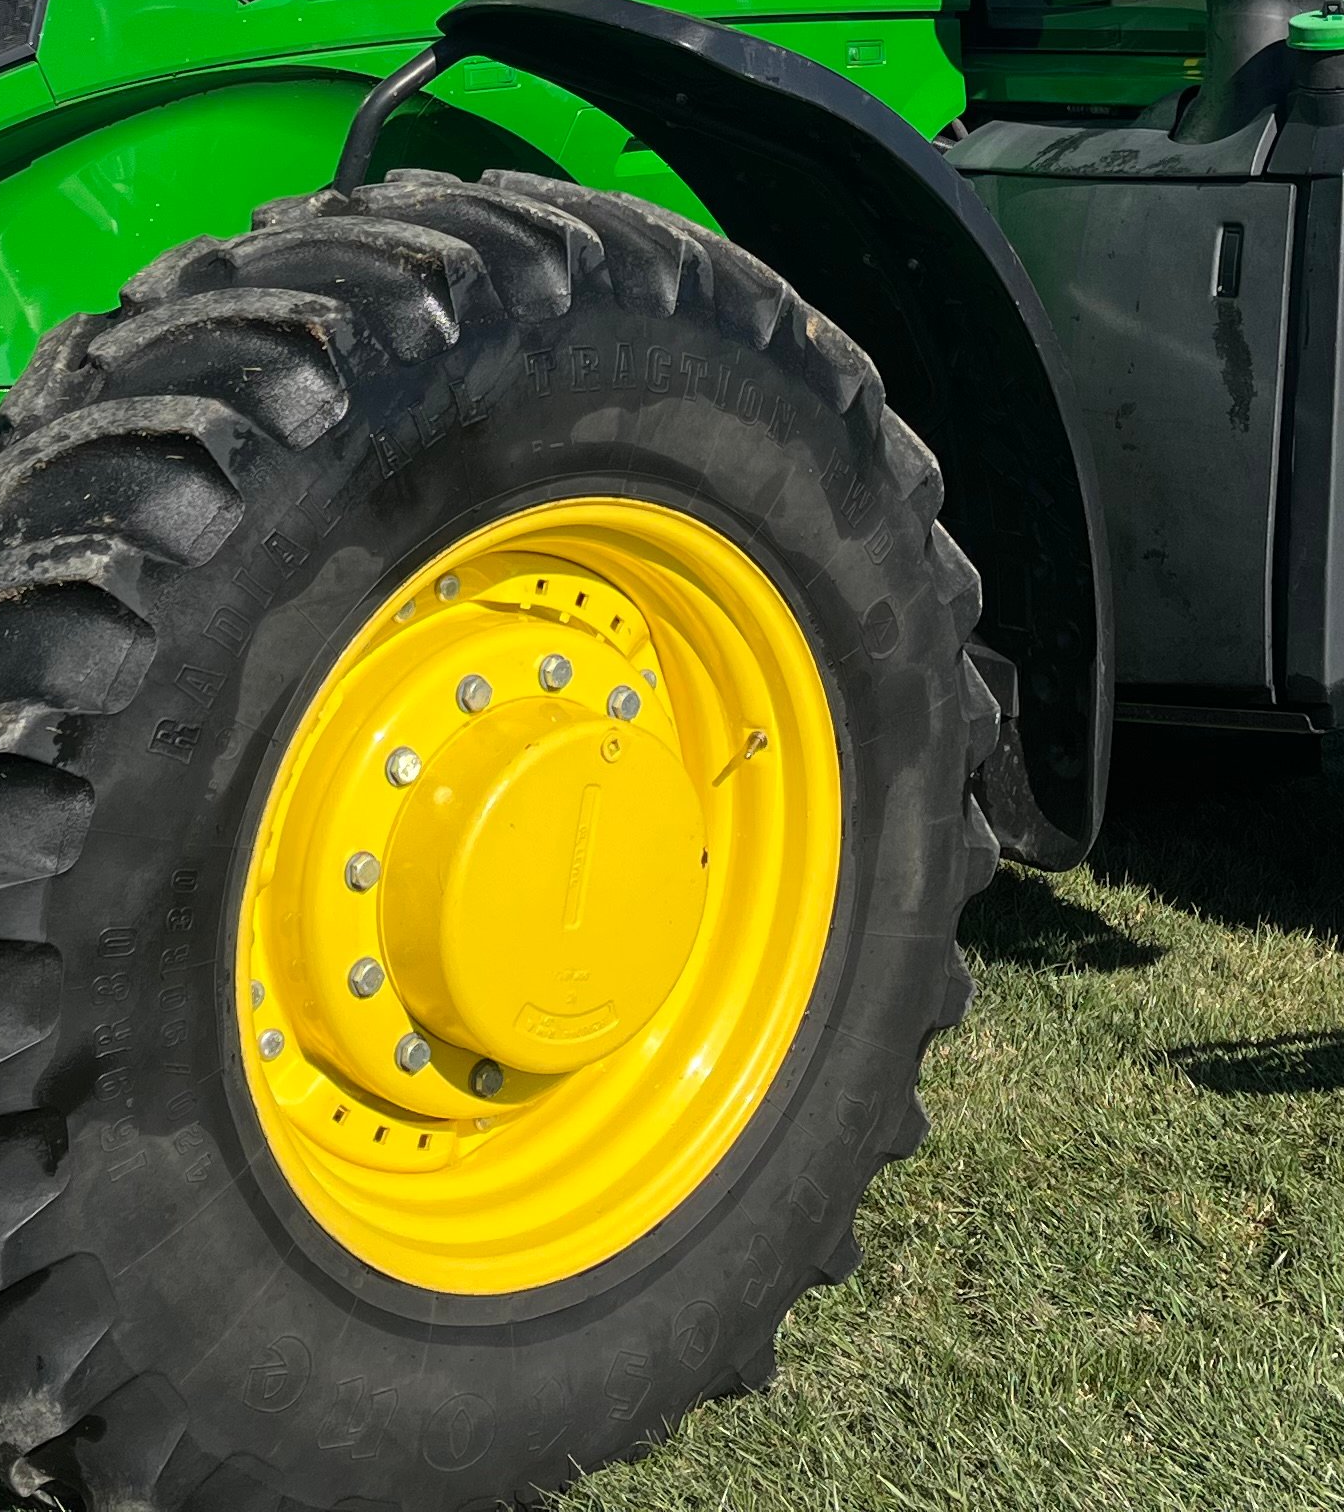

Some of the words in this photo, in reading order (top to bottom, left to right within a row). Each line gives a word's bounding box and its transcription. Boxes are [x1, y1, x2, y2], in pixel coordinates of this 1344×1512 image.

[147, 490, 343, 764] RADIAL
[369, 380, 489, 479] ALL
[524, 341, 799, 449] TRACTION
[819, 446, 897, 566] FWD
[90, 925, 148, 1186] 16.9R30
[158, 866, 211, 1185] 420/90R30
[242, 1089, 880, 1472] Firestone
